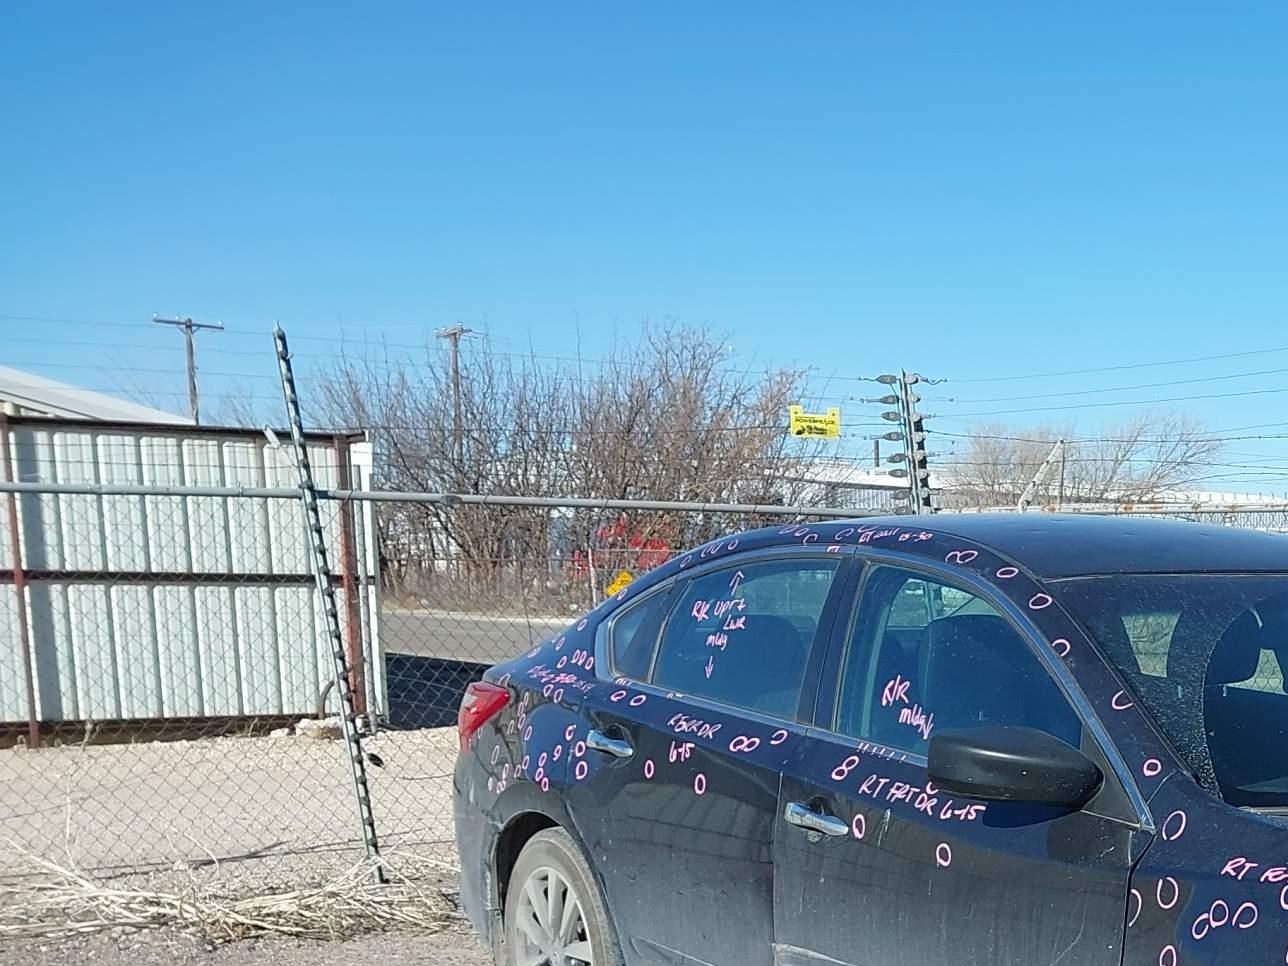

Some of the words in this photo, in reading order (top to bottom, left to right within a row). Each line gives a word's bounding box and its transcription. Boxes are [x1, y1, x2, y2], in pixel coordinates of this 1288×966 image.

[858, 774, 890, 798] RT
[940, 799, 987, 821] 6-15
[1220, 857, 1259, 880] RT
